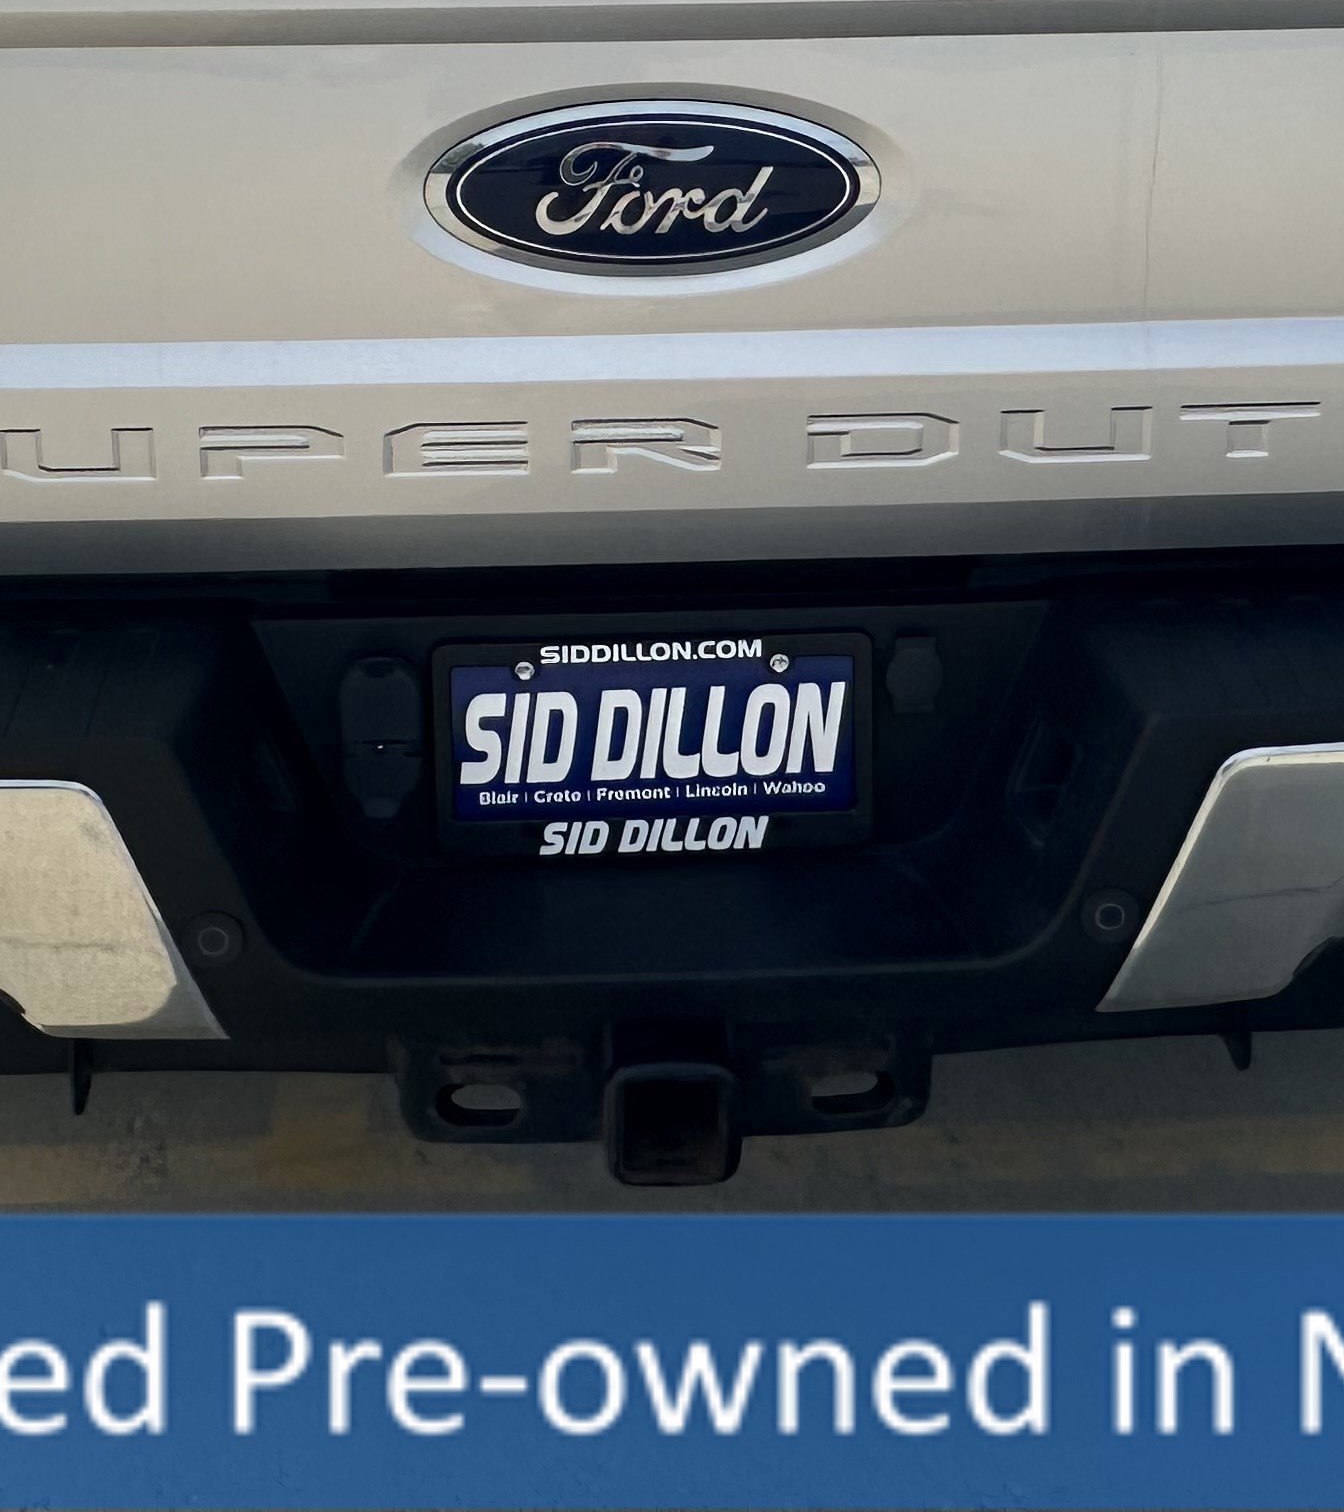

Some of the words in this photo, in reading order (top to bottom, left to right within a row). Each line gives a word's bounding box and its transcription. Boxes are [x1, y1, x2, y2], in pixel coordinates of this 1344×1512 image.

[535, 141, 774, 234] Ford
[540, 639, 762, 665] SIDDILLON.COM
[459, 691, 578, 785] SID
[591, 681, 846, 781] DILLON
[539, 822, 609, 856] SID
[617, 816, 769, 854] DILLON
